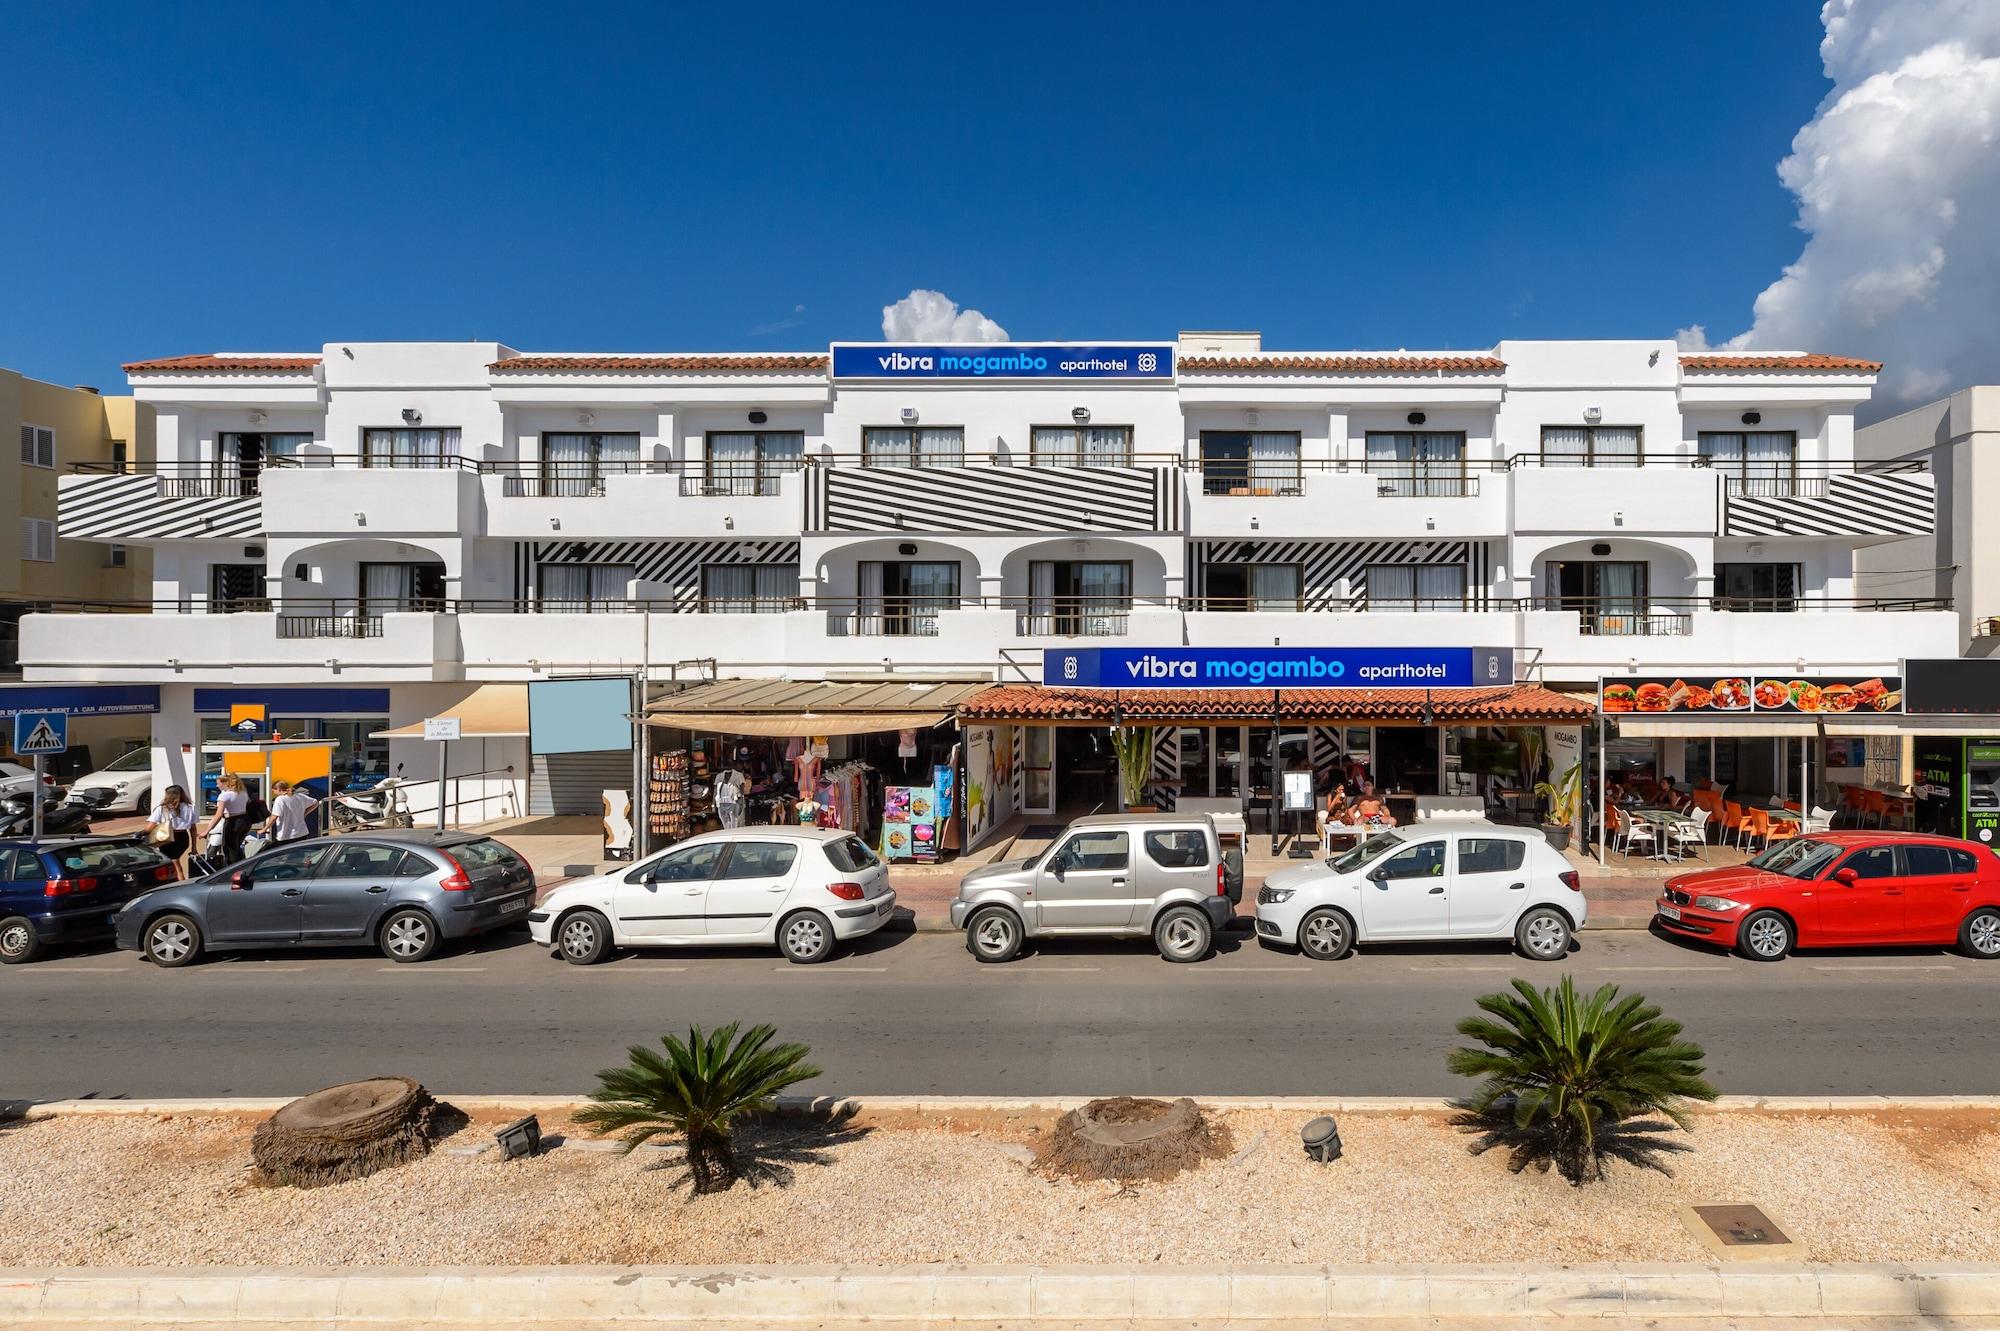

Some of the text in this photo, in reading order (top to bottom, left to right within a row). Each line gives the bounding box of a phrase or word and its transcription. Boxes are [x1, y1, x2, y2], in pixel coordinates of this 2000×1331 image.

[878, 352, 1127, 375] vibra mogambo aparthotel
[1126, 655, 1447, 684] vibra mogambo aparthotel
[1927, 769, 1950, 783] ATM
[1975, 818, 1997, 828] ATM
